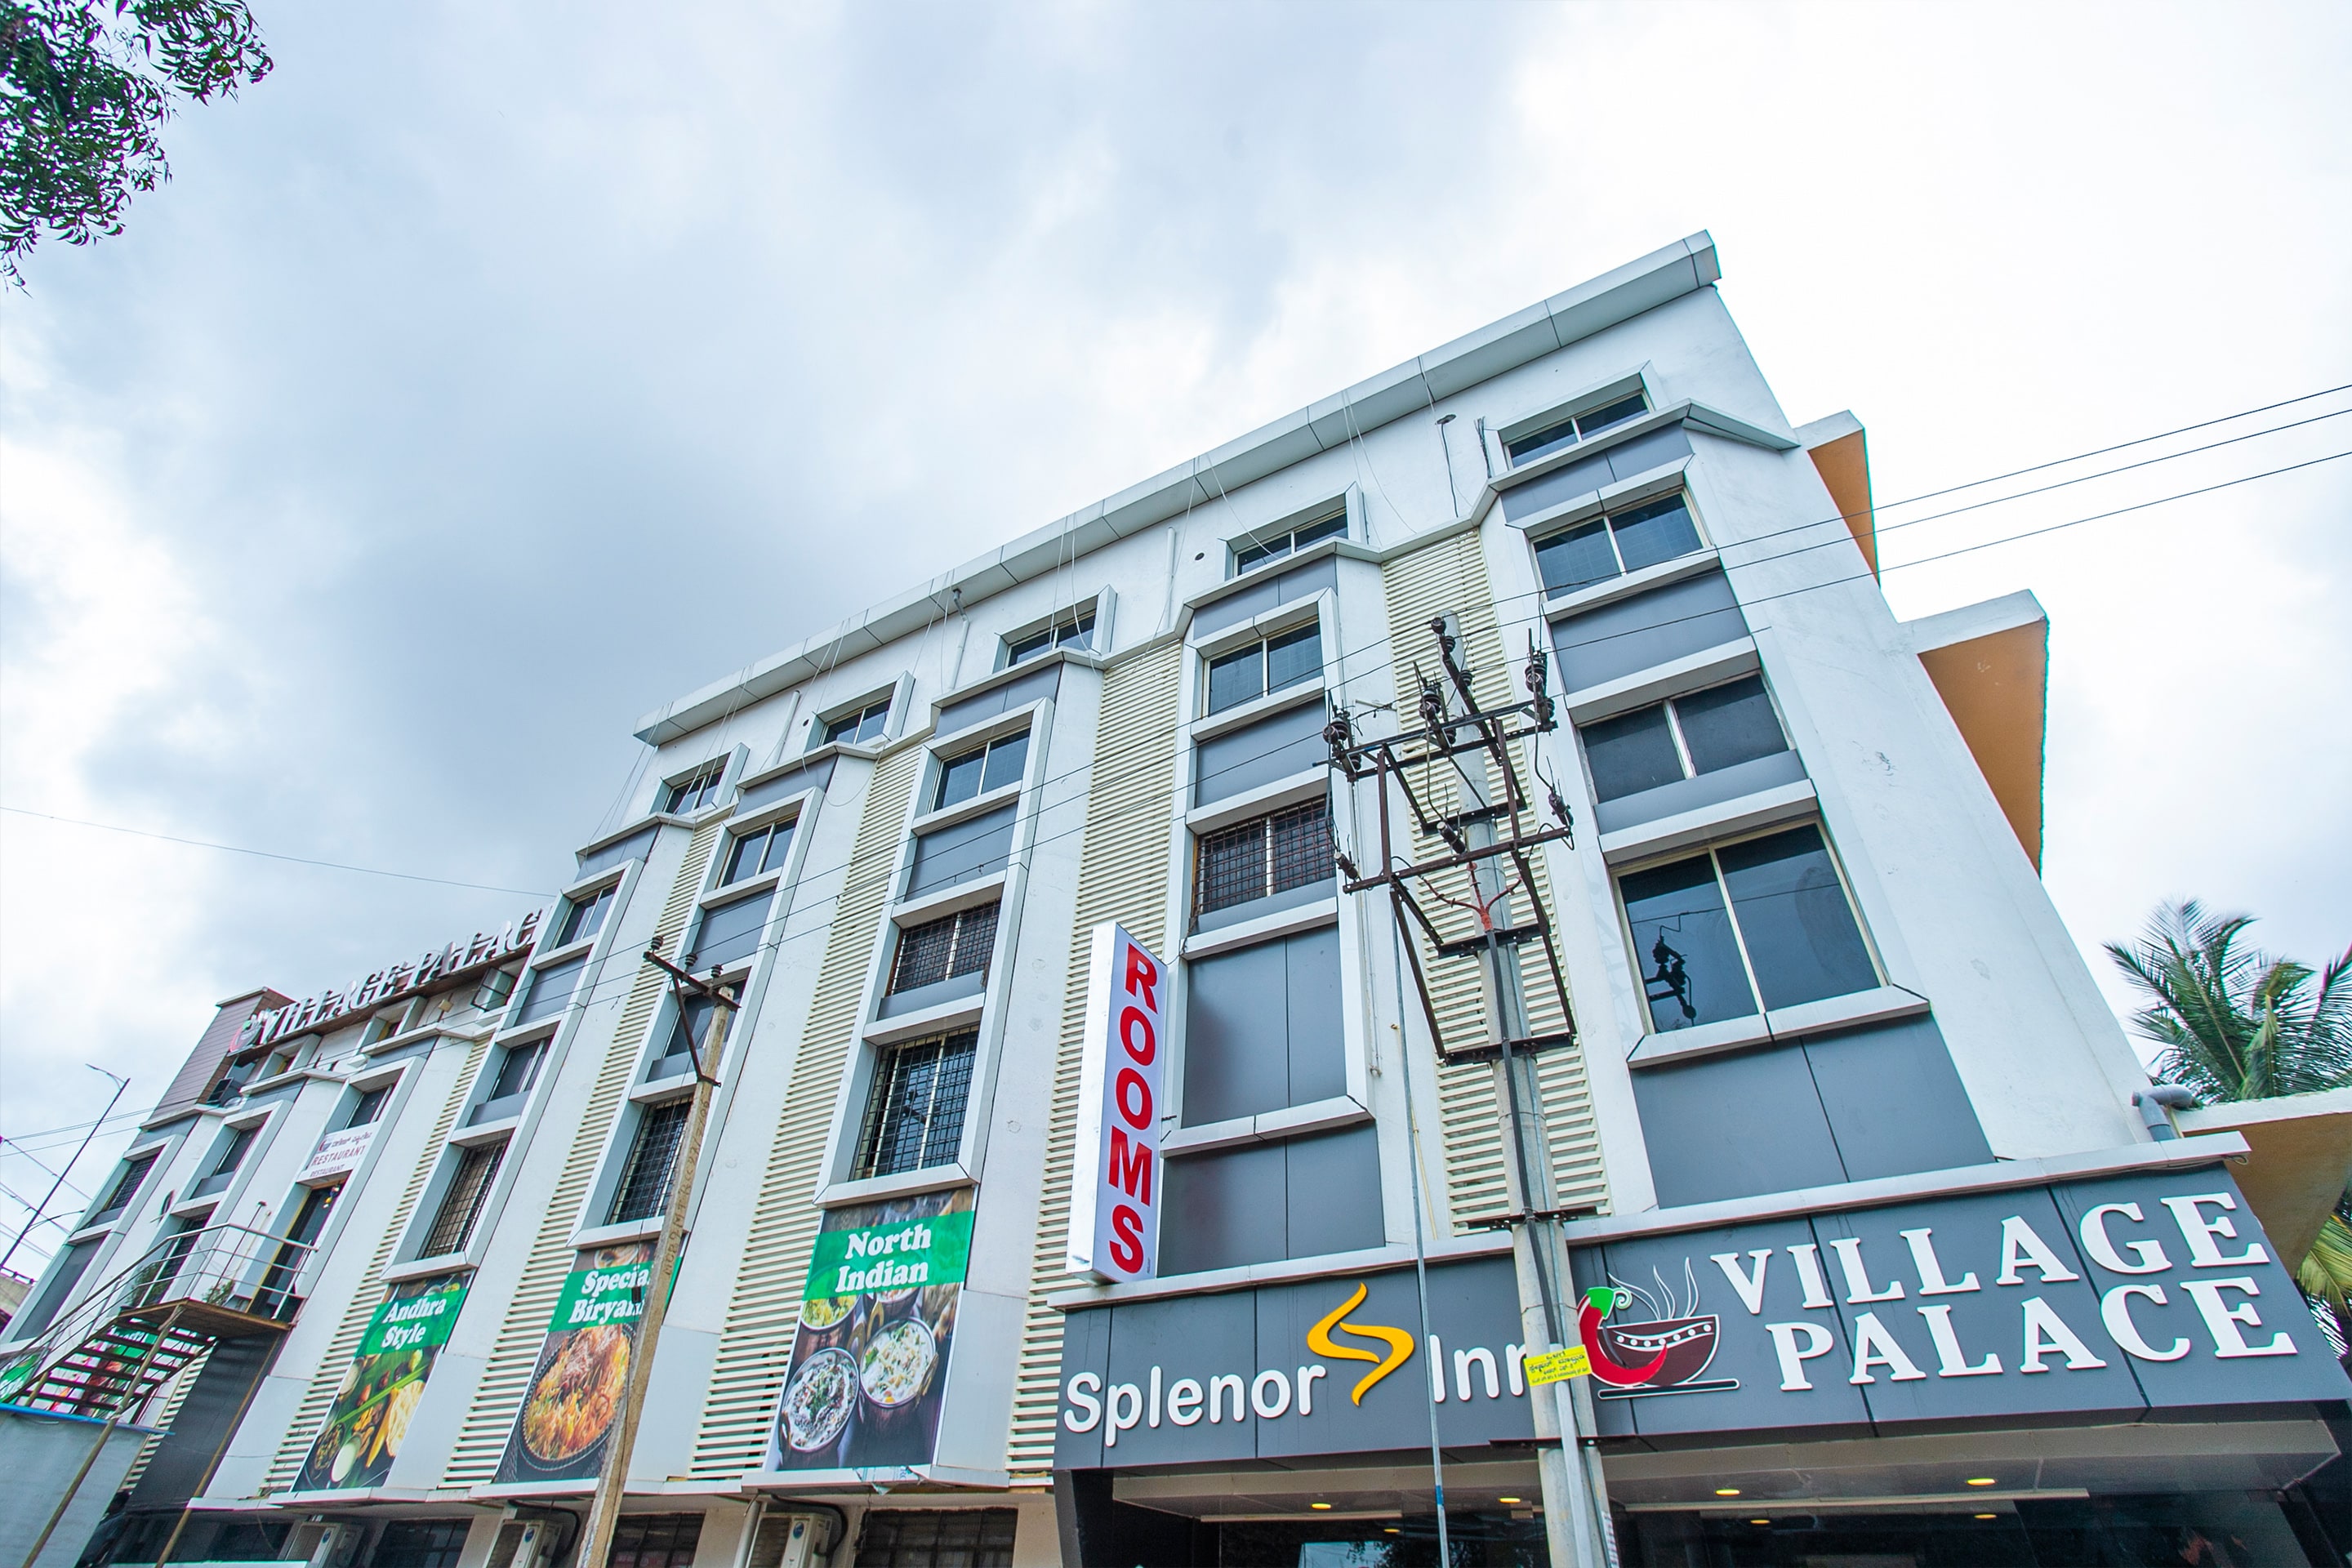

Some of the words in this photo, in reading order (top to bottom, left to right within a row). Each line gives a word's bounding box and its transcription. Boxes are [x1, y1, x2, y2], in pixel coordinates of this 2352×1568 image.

[260, 960, 408, 1045] VILLAGE
[1109, 942, 1159, 1274] ROOMS
[310, 1165, 345, 1177] RESTAURANT
[311, 1145, 366, 1166] RESTAURANT
[844, 1223, 932, 1259] North
[1710, 1192, 2270, 1316] VILLAGE
[835, 1259, 929, 1293] Indian
[381, 1297, 447, 1324] Andhra
[381, 1322, 426, 1350] Style
[1765, 1276, 2299, 1392] PALACE
[1063, 1364, 1326, 1448] Splenor
